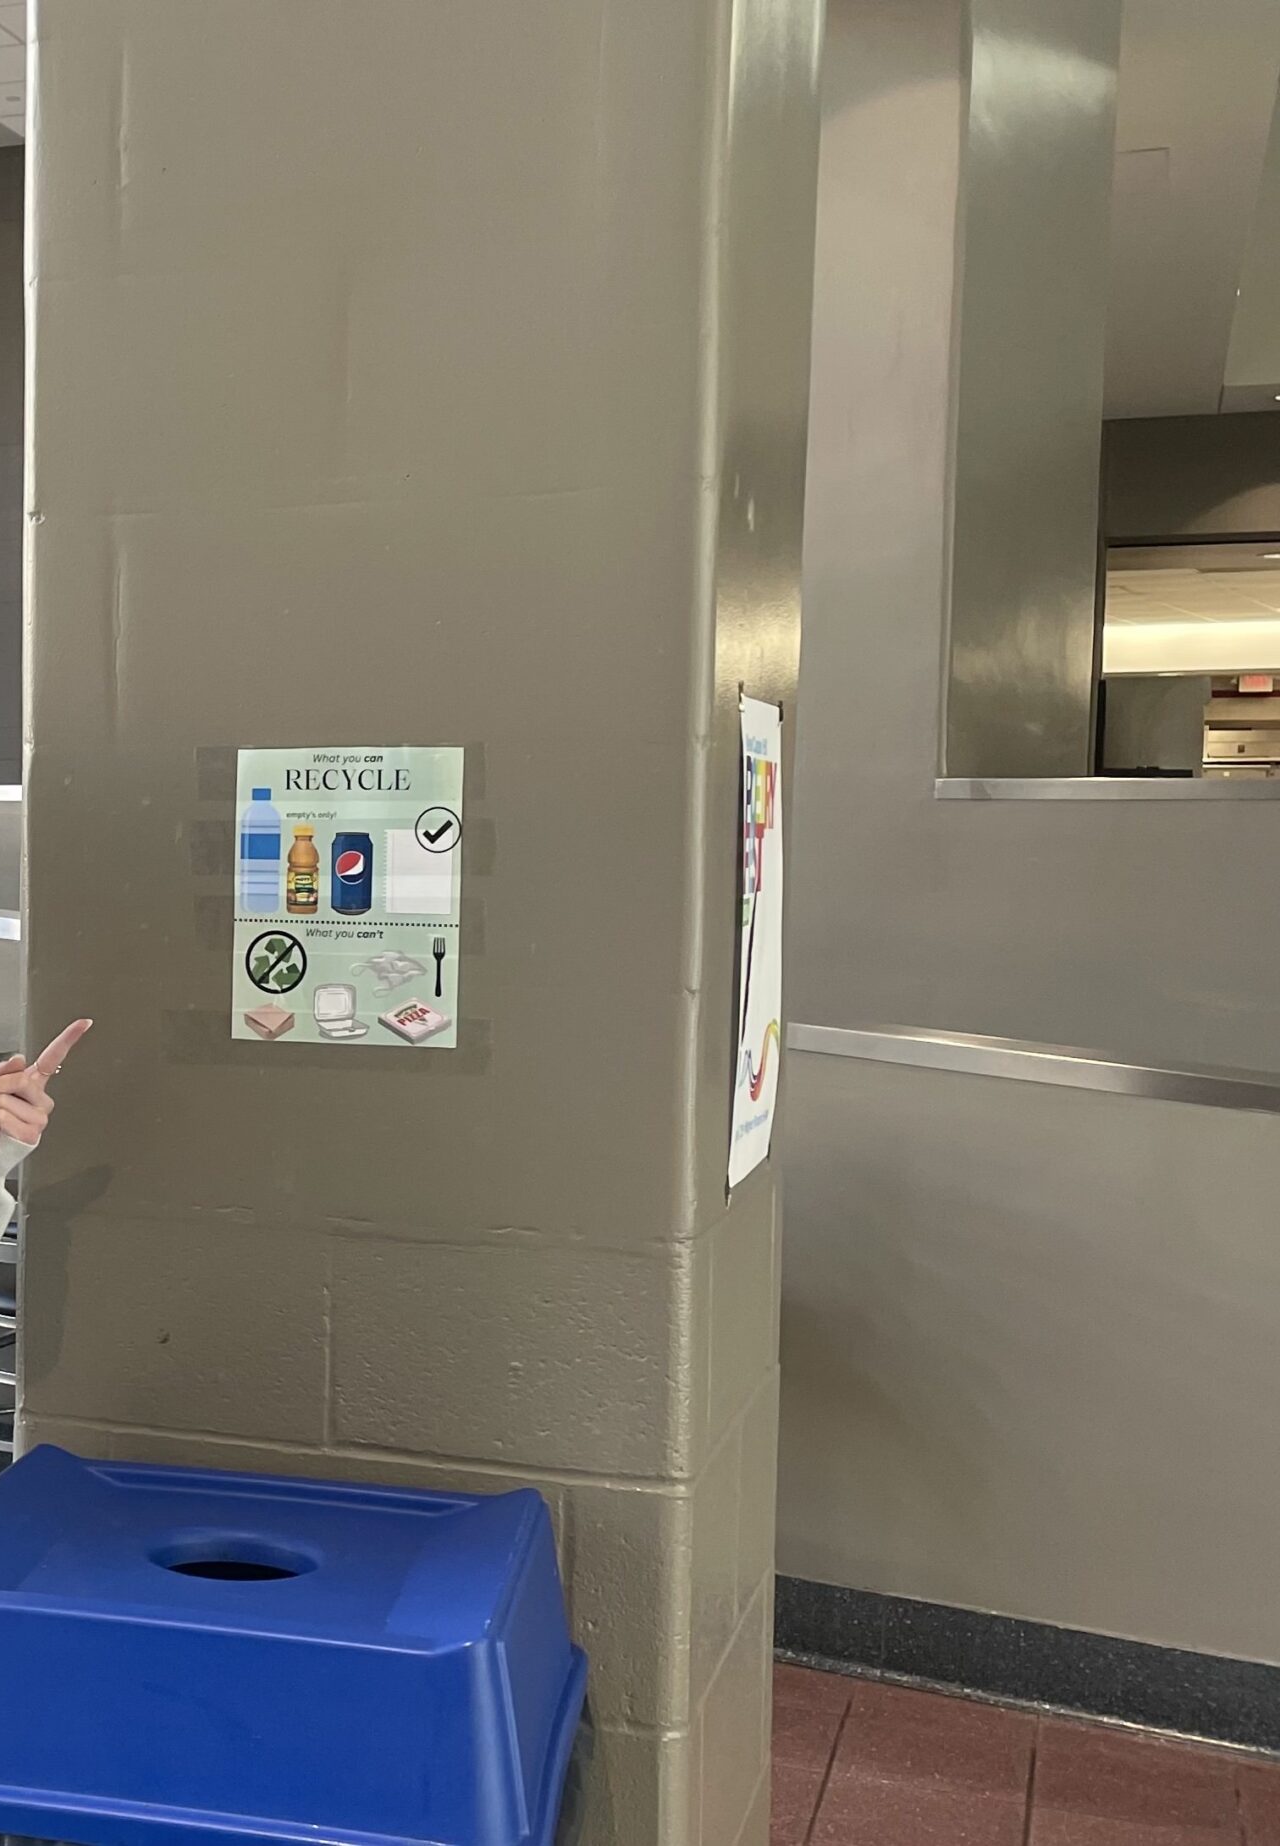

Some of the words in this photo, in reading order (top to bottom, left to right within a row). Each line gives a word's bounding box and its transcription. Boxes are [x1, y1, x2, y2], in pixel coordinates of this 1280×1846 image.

[313, 753, 340, 764] What
[341, 755, 362, 766] you
[363, 755, 384, 763] can
[285, 768, 412, 791] RECYCLE
[305, 928, 333, 938] What
[334, 930, 355, 941] you
[356, 930, 384, 939] can't
[396, 1007, 431, 1026] PIZZA
